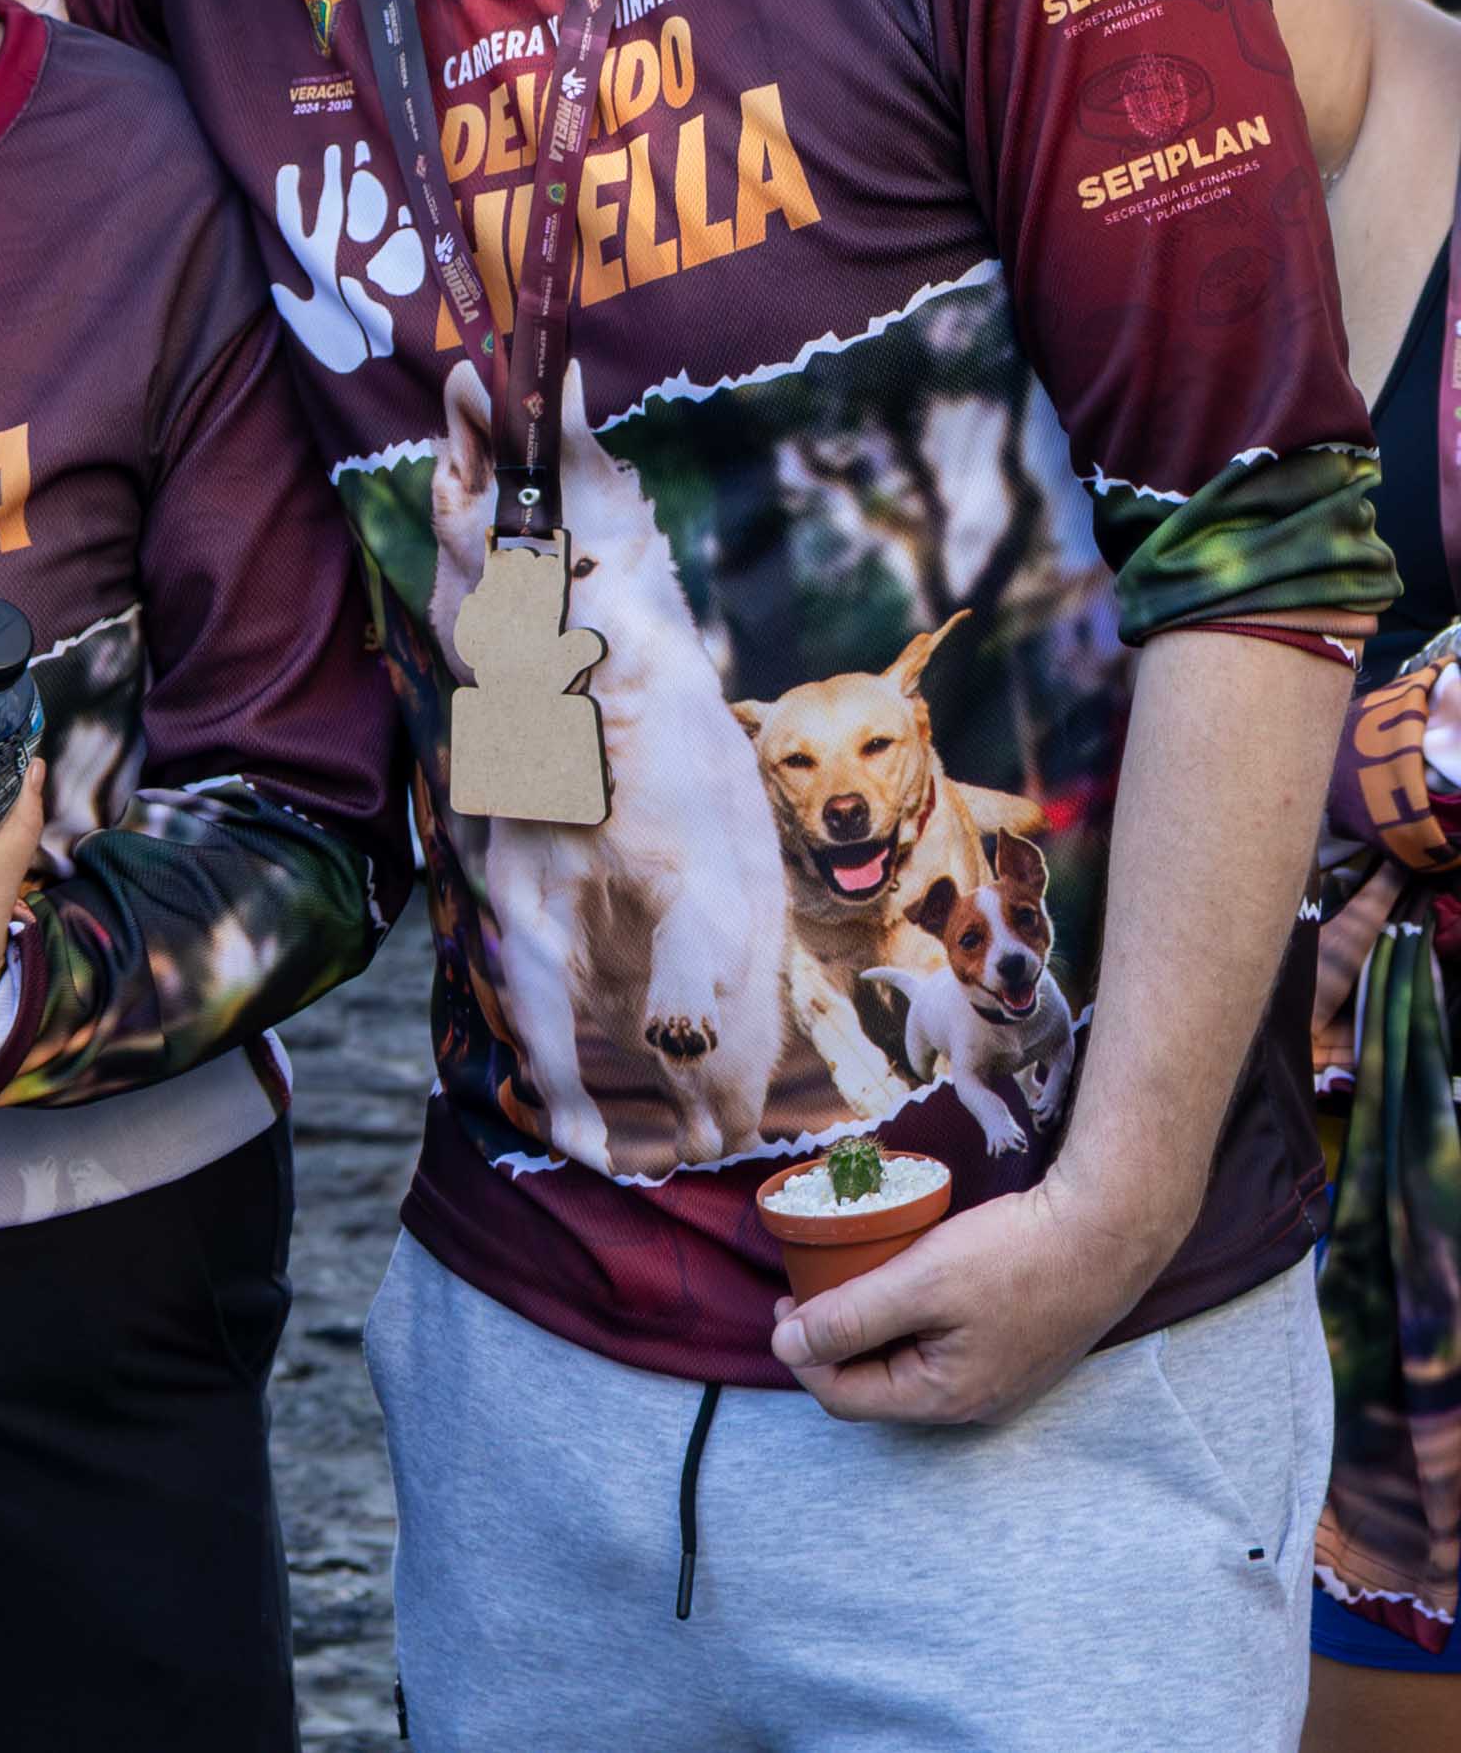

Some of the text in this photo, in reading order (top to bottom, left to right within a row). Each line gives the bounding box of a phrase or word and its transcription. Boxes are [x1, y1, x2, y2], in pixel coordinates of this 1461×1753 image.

[1102, 4, 1165, 38] AMBIENTE
[443, 25, 545, 91] CARRERA
[547, 14, 562, 46] Y
[289, 79, 356, 103] VERACRUZ
[292, 102, 320, 117] 2024
[548, 94, 573, 165] HUELLA
[1077, 114, 1272, 210] SEFIPLAN
[1180, 178, 1199, 197] DE
[1199, 159, 1261, 190] FINANZAS
[1143, 212, 1154, 226] Y
[440, 261, 480, 325] HUELLA
